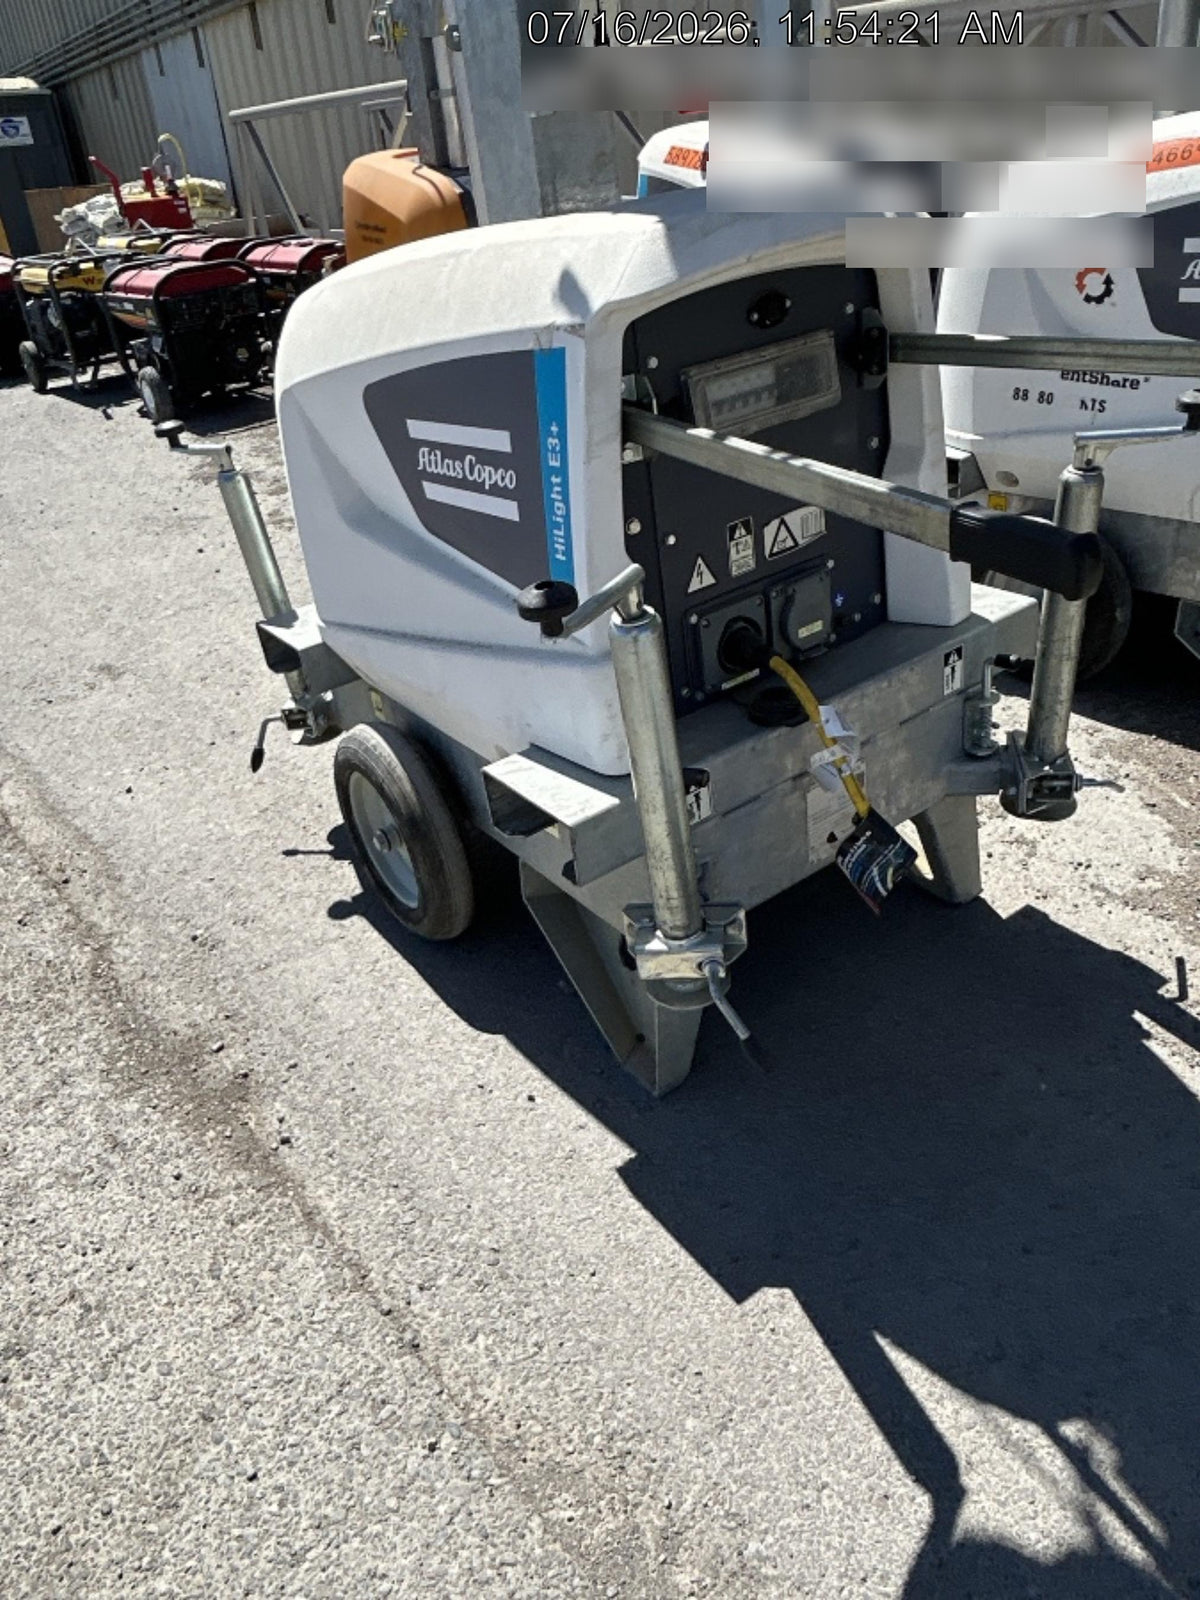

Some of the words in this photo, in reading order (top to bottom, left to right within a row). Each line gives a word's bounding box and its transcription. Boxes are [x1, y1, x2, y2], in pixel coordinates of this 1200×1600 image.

[547, 421, 561, 467] E3+
[417, 447, 463, 479] Atlas
[464, 454, 517, 490] Copco
[550, 475, 567, 561] HiLight
